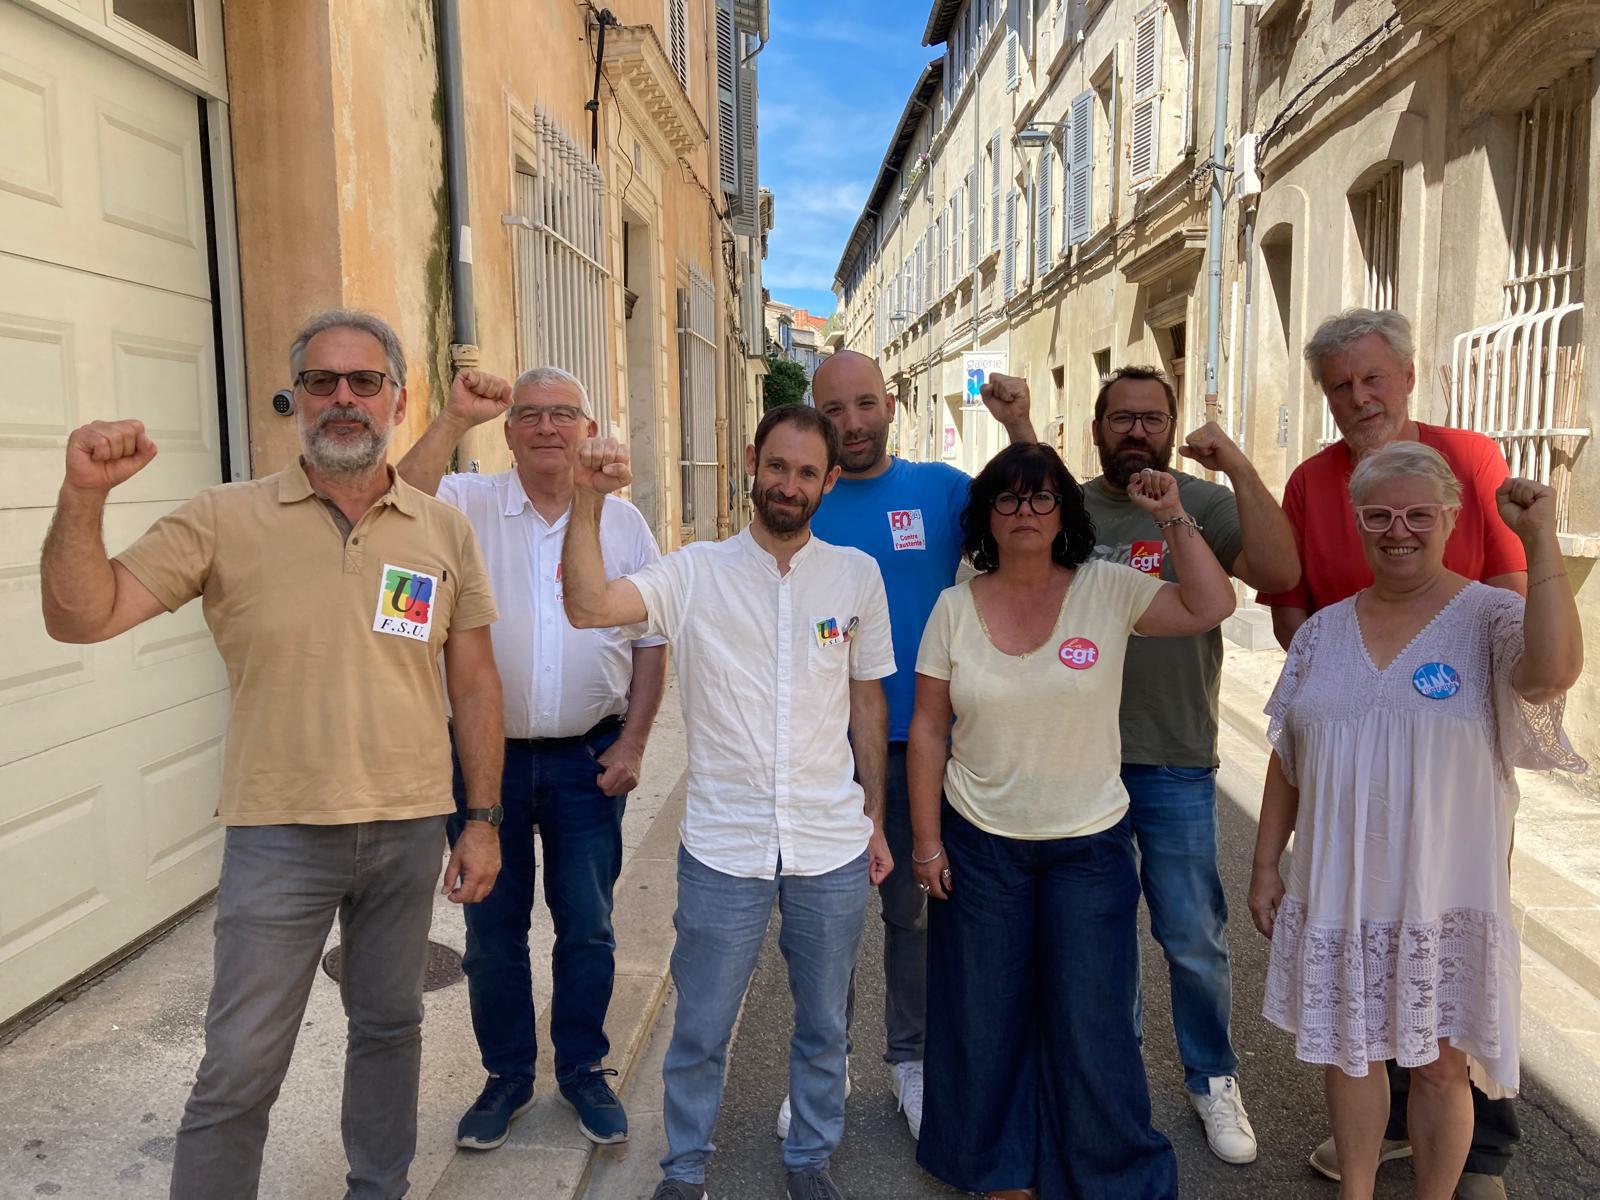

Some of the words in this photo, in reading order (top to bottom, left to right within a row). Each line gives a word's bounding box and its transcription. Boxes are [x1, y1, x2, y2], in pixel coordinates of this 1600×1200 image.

[966, 358, 1003, 369] galerie
[891, 511, 911, 530] FO
[1130, 552, 1160, 572] cgt
[1060, 647, 1096, 665] cgt
